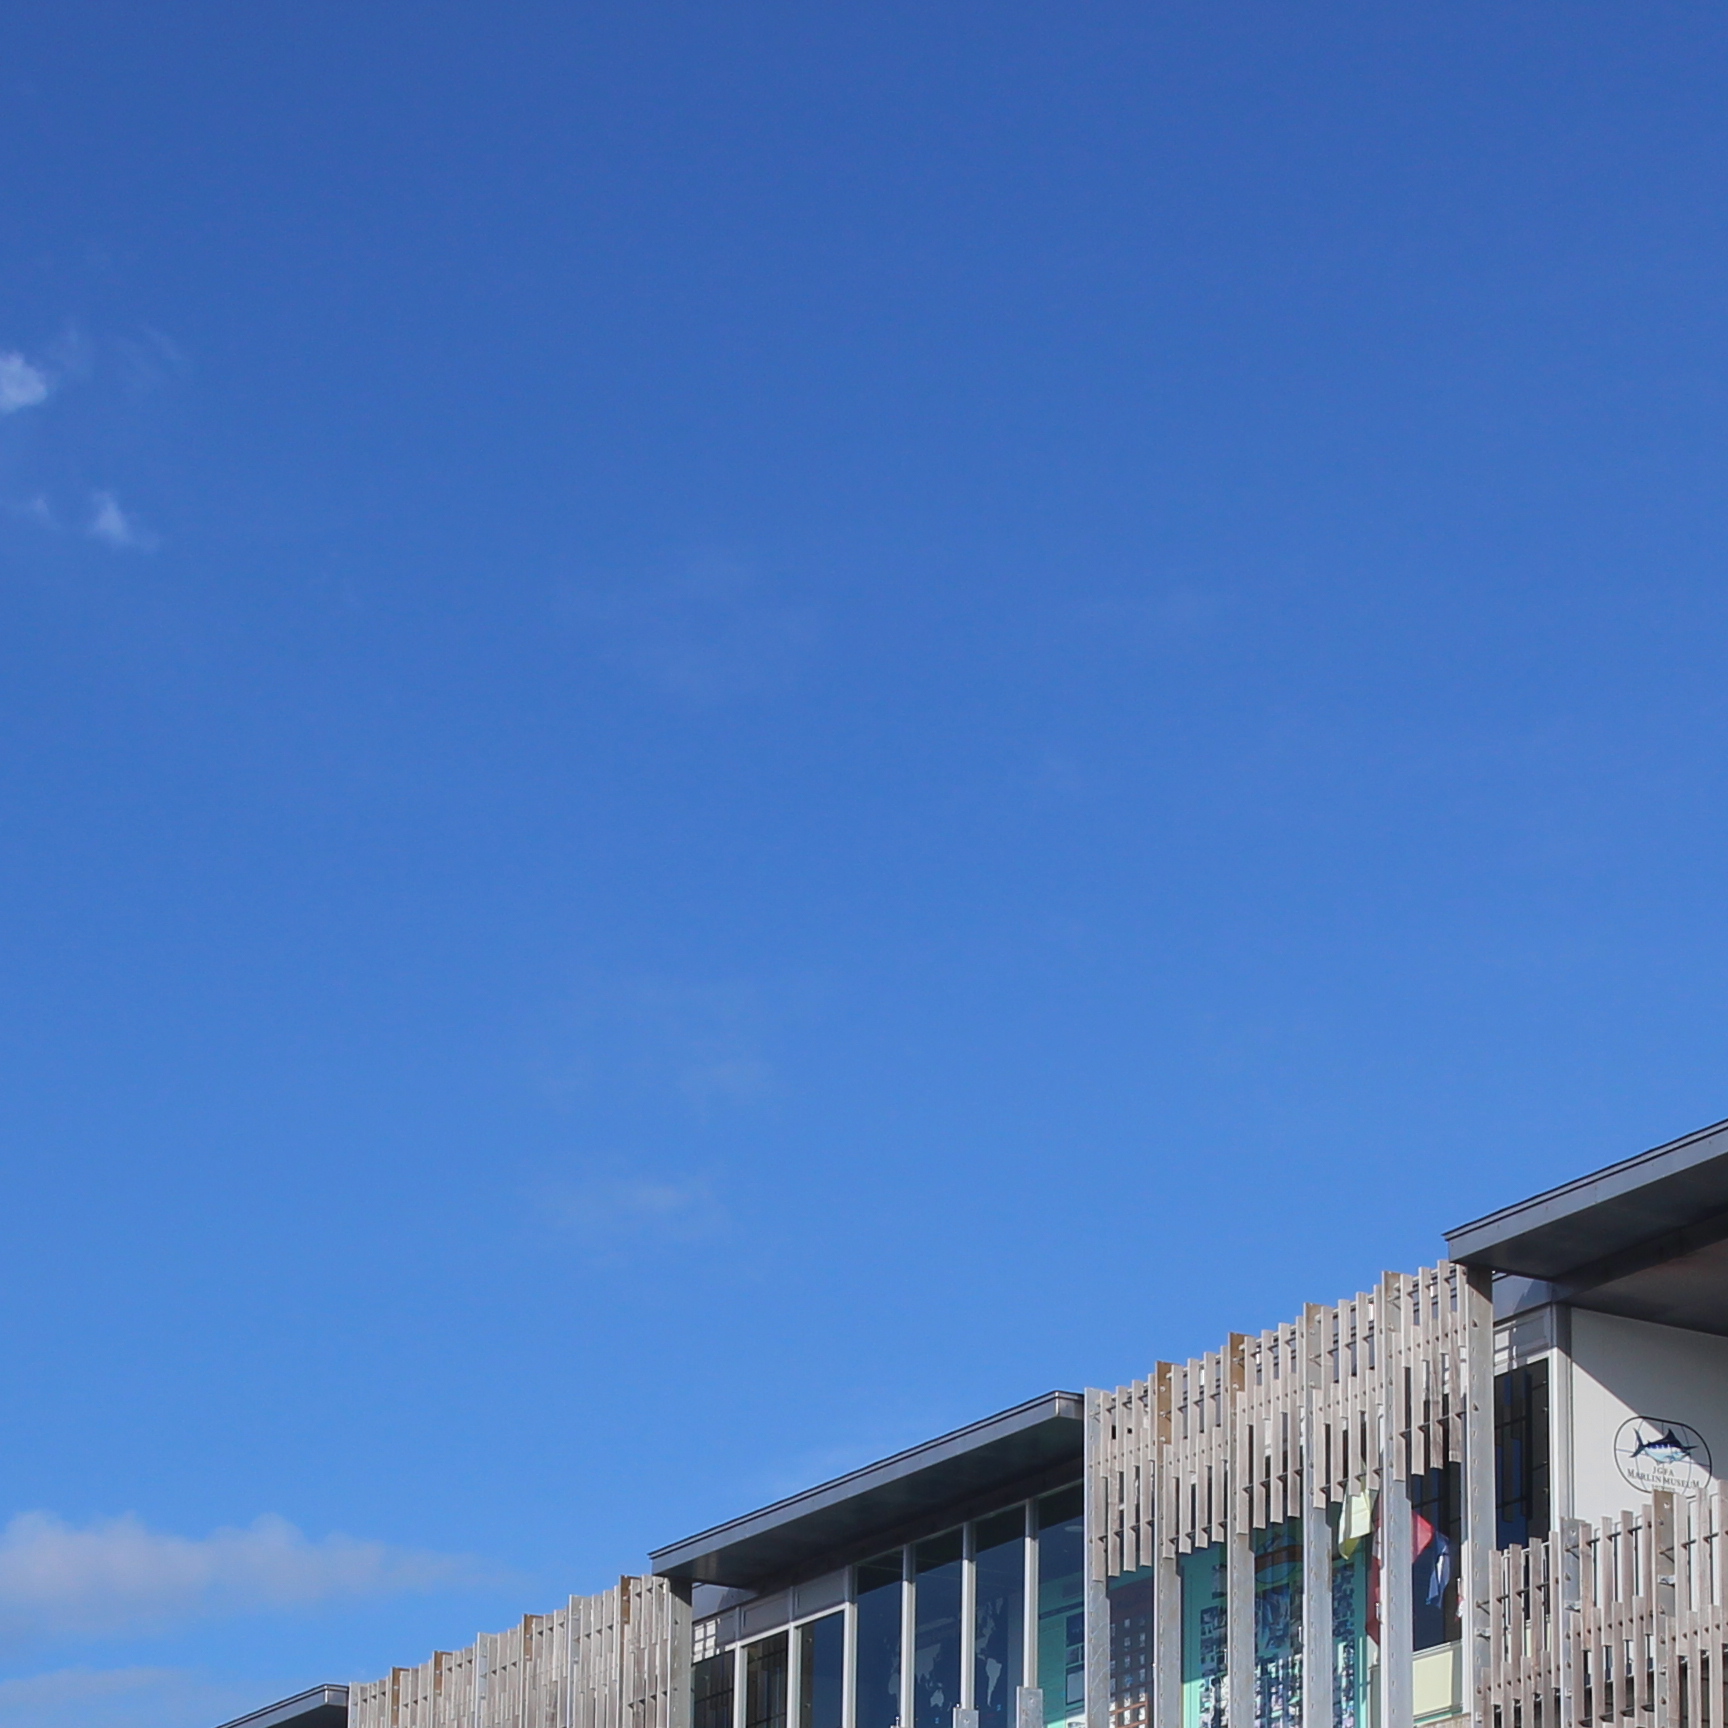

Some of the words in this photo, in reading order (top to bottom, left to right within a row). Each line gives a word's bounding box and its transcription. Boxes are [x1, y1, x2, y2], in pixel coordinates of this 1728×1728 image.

[1627, 1468, 1662, 1483] MARLIN
[1662, 1475, 1700, 1489] MUSEUM
[1652, 1466, 1675, 1477] JGFA
